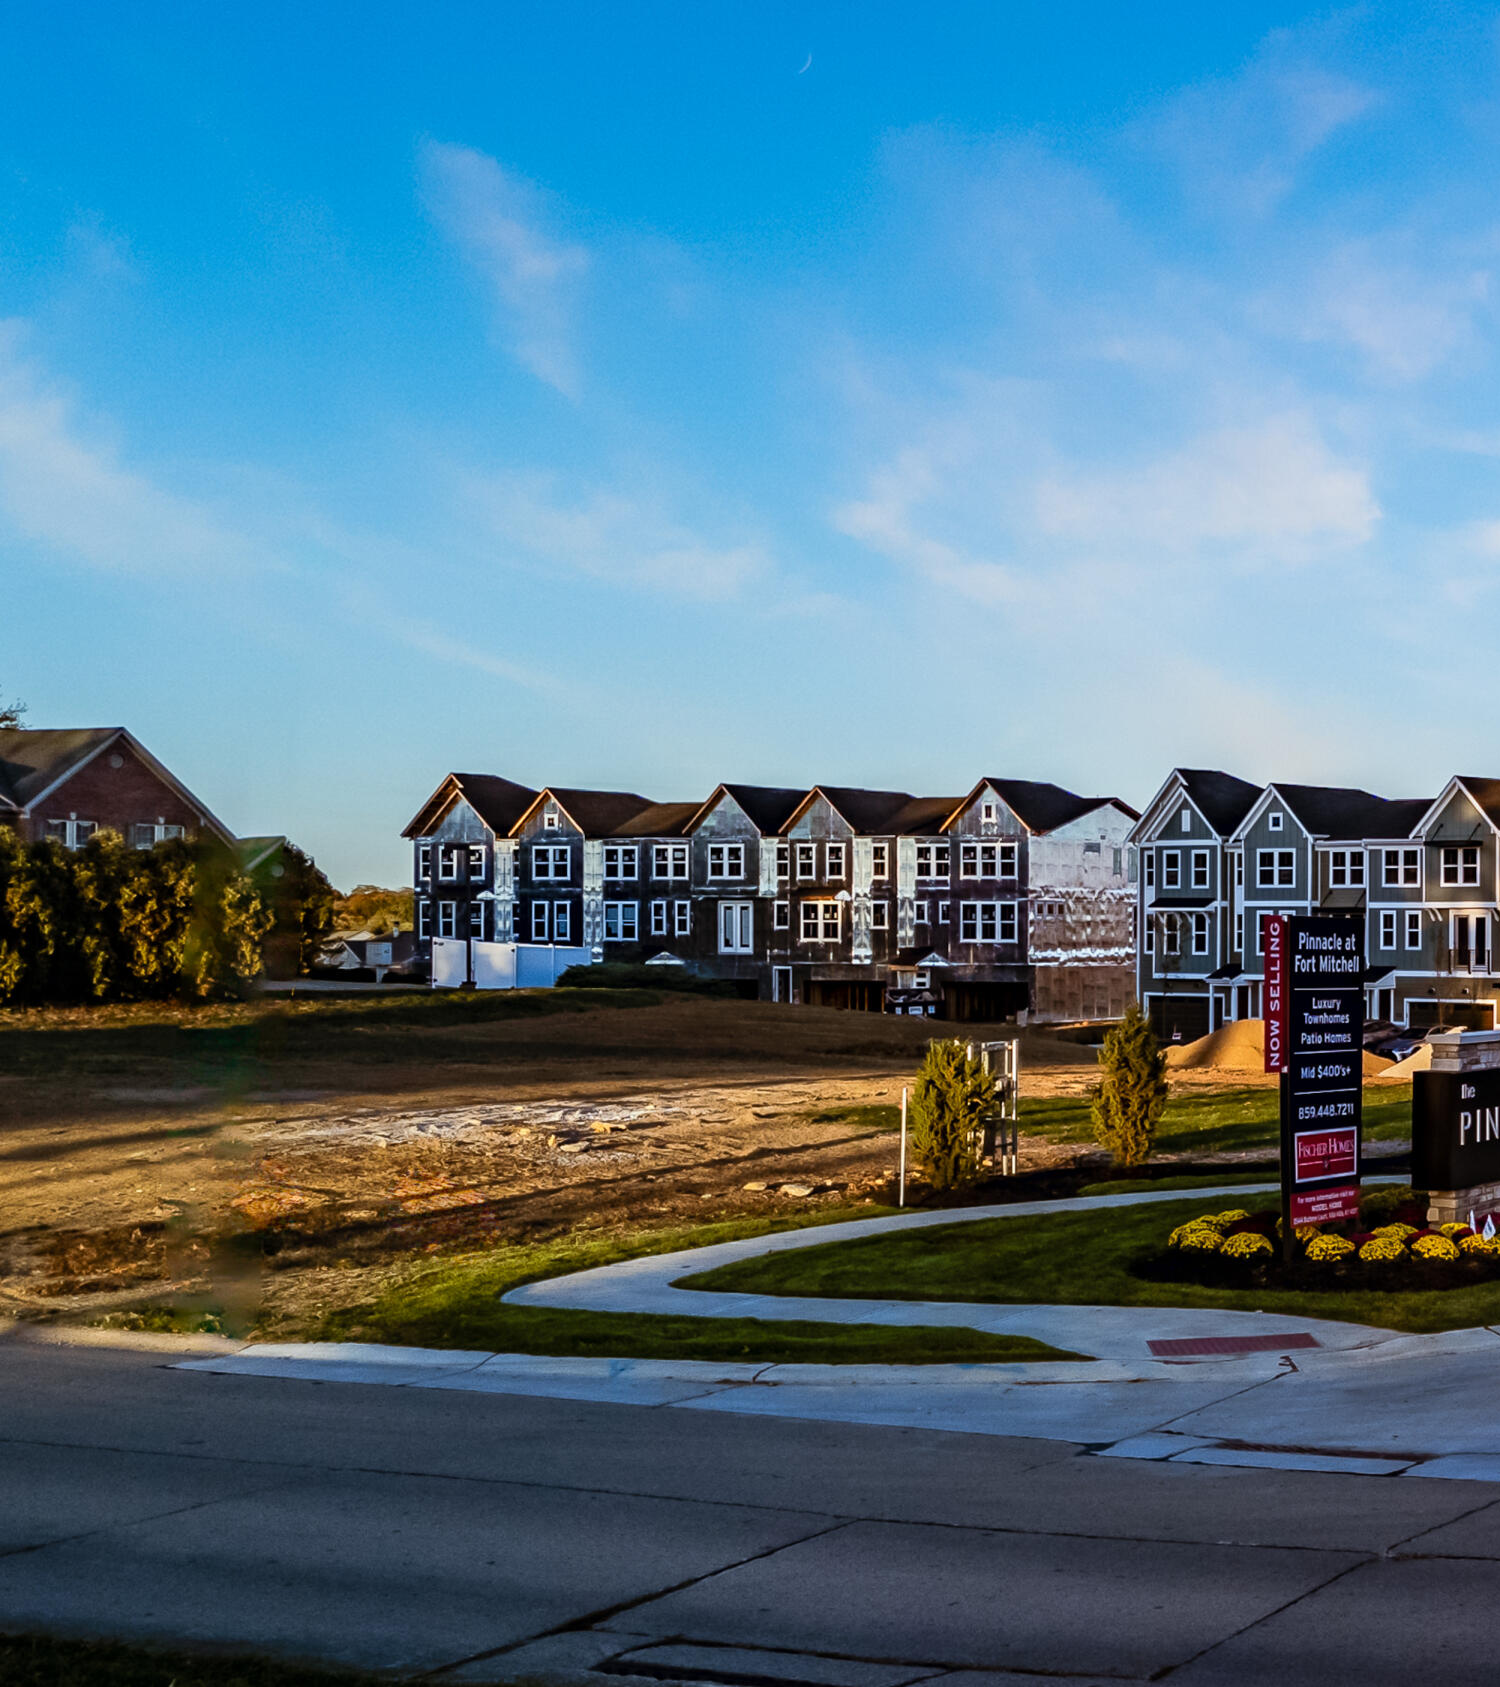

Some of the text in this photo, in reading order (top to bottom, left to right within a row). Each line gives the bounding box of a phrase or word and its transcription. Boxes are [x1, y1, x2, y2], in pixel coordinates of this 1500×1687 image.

[1298, 932, 1356, 951] Pinnacle at
[1294, 955, 1360, 973] Fort Mitchell
[1269, 922, 1280, 1067] NOW SELLING
[1312, 997, 1342, 1011] Luxury
[1303, 1012, 1350, 1025] Townhomes
[1300, 1032, 1352, 1045] Patio Homes
[1300, 1066, 1316, 1080] Mid
[1461, 1083, 1476, 1100] the
[1298, 1103, 1355, 1120] 859.448.7211
[1298, 1137, 1354, 1159] FISCHER HOMES
